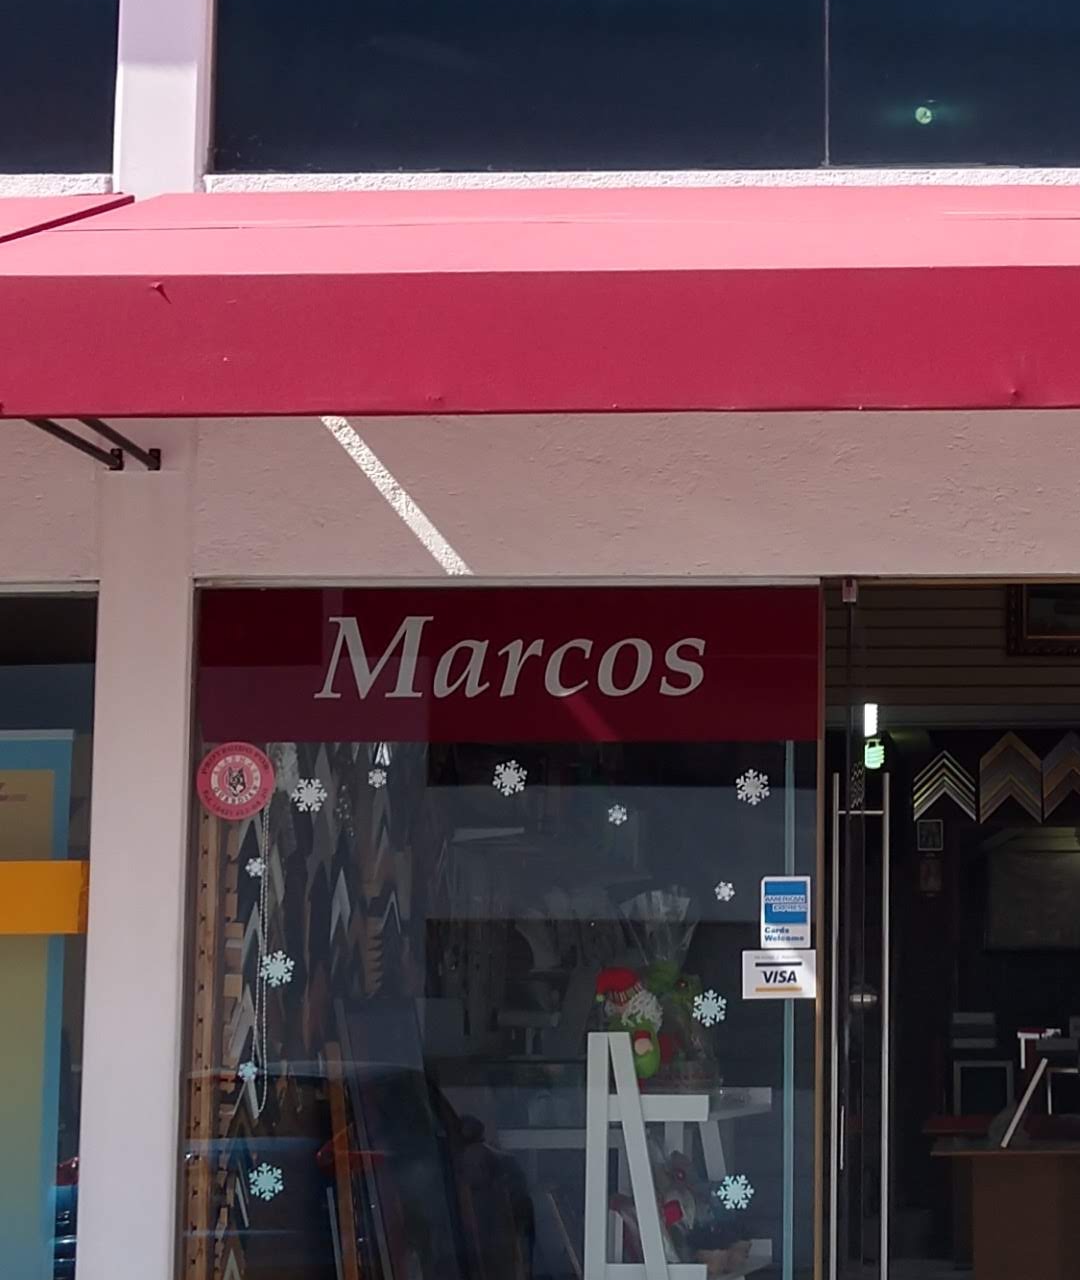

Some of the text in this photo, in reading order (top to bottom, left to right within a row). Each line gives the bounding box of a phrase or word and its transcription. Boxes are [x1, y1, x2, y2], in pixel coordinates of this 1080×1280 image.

[313, 615, 707, 700] Marcos
[765, 895, 805, 903] AMERICAN
[765, 926, 790, 934] Cards
[762, 970, 798, 984] VISA
